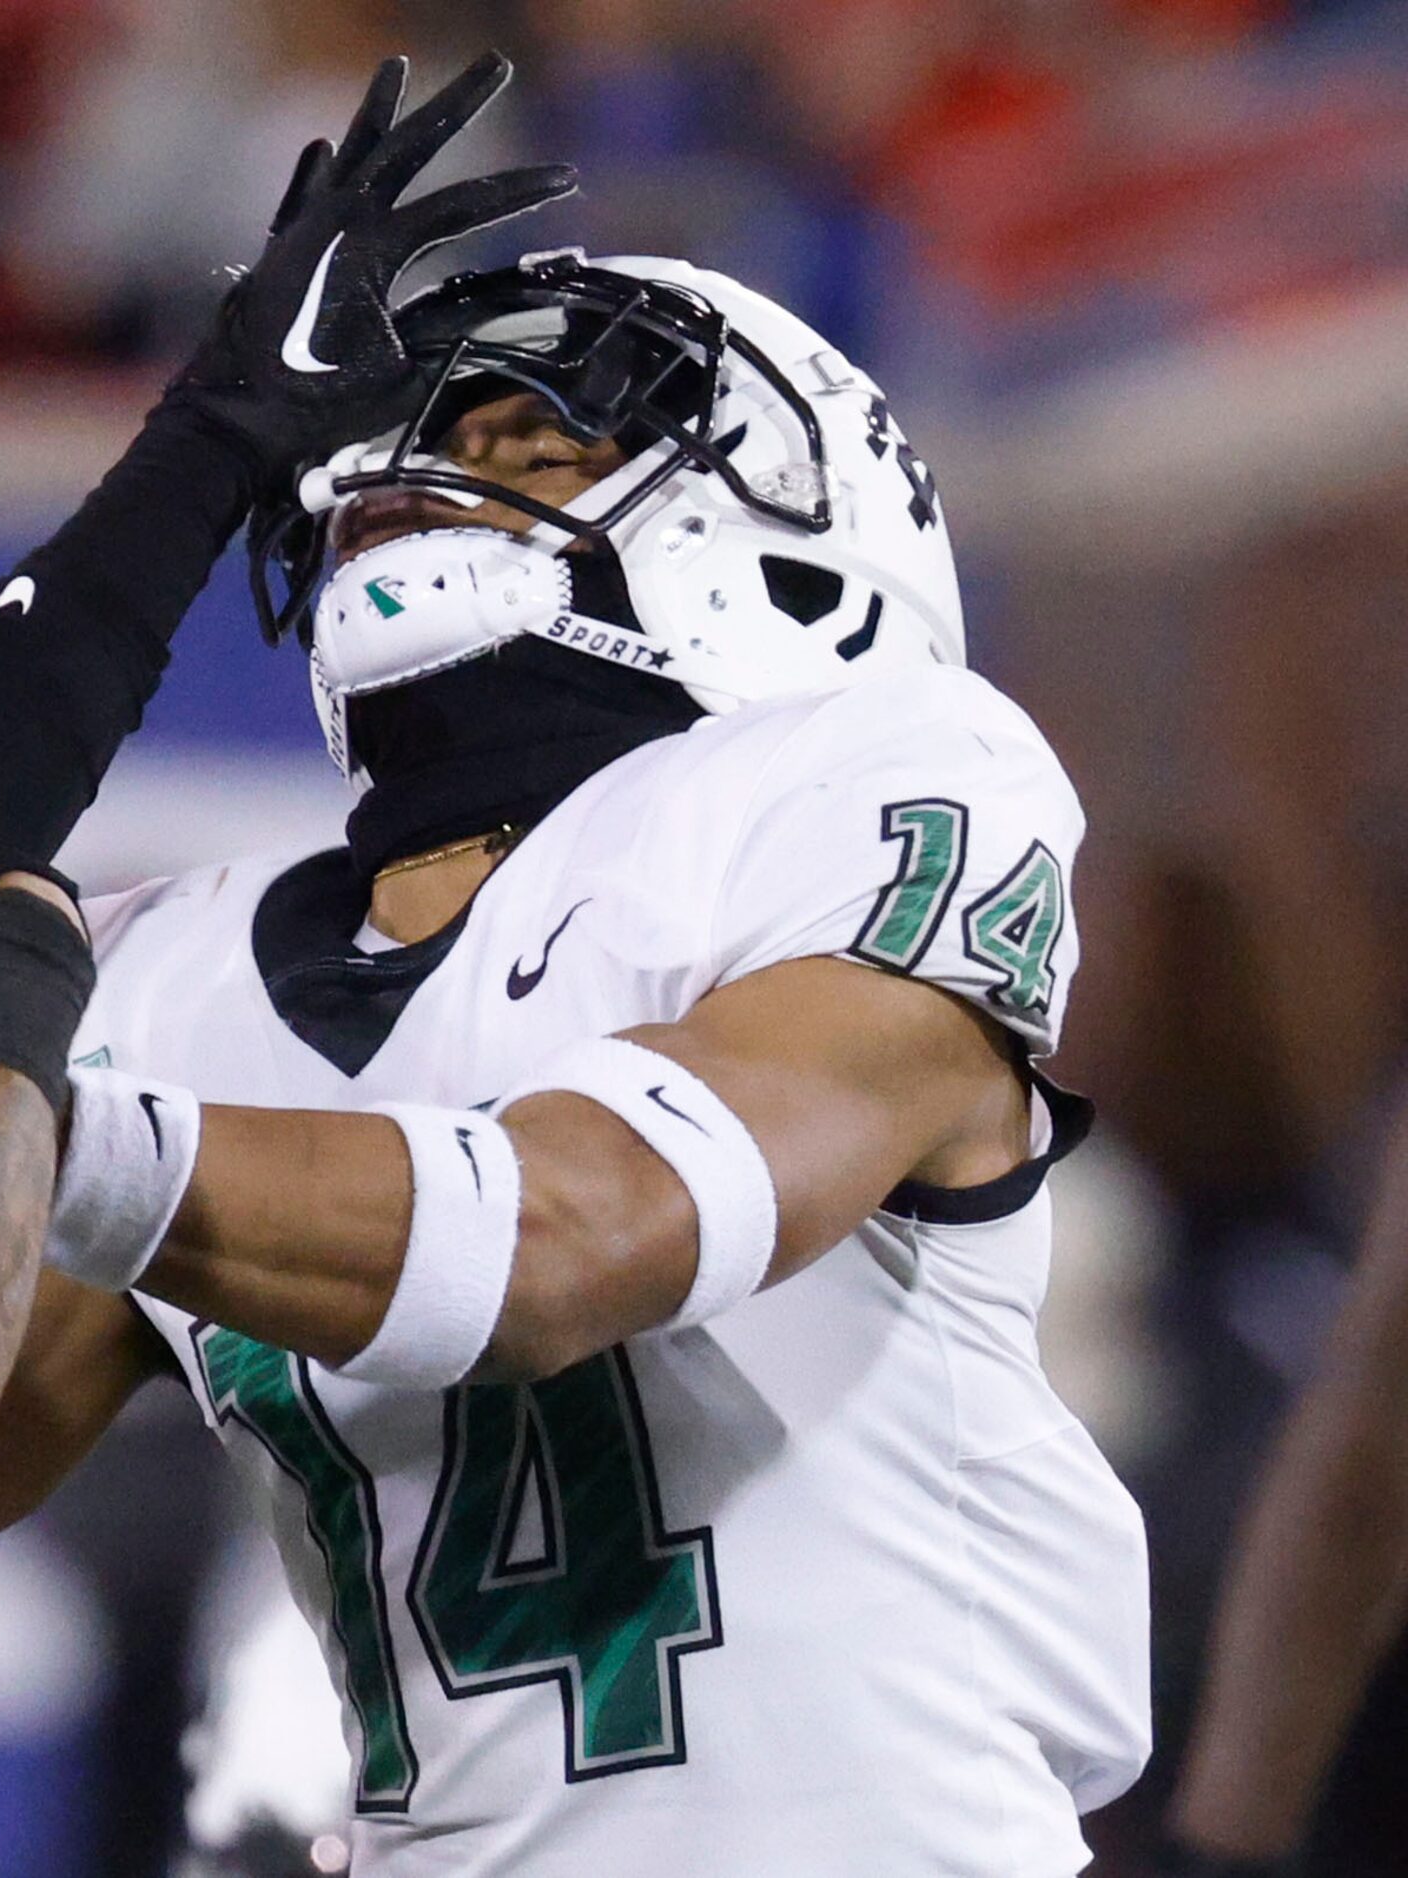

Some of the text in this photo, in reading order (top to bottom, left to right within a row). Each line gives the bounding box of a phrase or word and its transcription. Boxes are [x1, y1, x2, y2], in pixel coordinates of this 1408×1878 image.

[547, 615, 649, 664] SPORT
[845, 797, 1064, 1016] 14
[188, 1318, 724, 1812] 14
